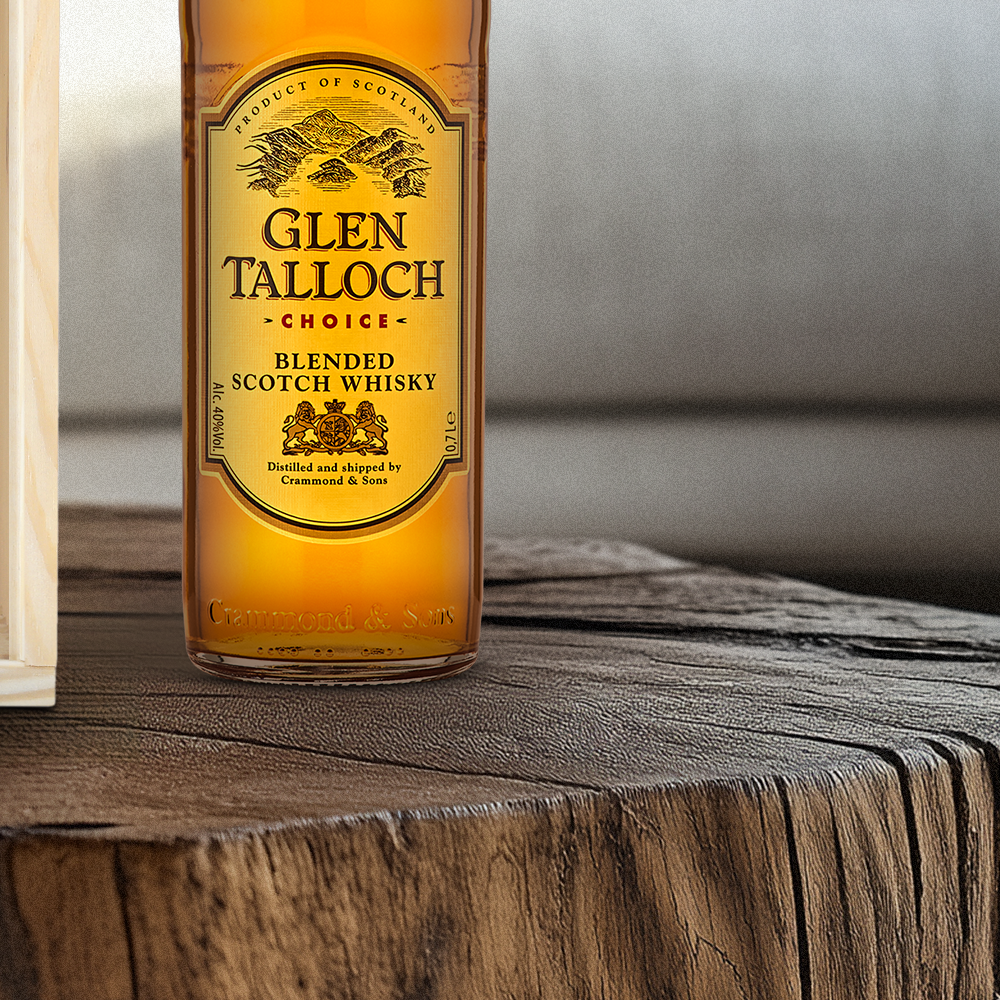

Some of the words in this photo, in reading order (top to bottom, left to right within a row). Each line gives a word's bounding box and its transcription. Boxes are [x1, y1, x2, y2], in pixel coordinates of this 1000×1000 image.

[234, 80, 307, 135] PRODUCT
[319, 77, 342, 88] OF
[352, 78, 436, 135] SCOTLAND
[261, 207, 407, 252] GLEN
[221, 255, 445, 301] TALLOCH
[281, 313, 389, 329] CHOICE
[274, 352, 395, 370] BLENDED
[212, 381, 225, 404] Alc.
[231, 373, 331, 392] SCOTCH
[340, 373, 437, 392] WHISKY
[267, 461, 313, 472] Distilled
[317, 461, 338, 472] and
[341, 461, 385, 474] shipped
[388, 461, 402, 473] by
[281, 475, 343, 486] Crammond
[347, 475, 358, 486] &
[362, 475, 388, 486] Sons
[207, 598, 355, 633] Crammond
[364, 603, 391, 630] &
[403, 601, 456, 629] Sons
